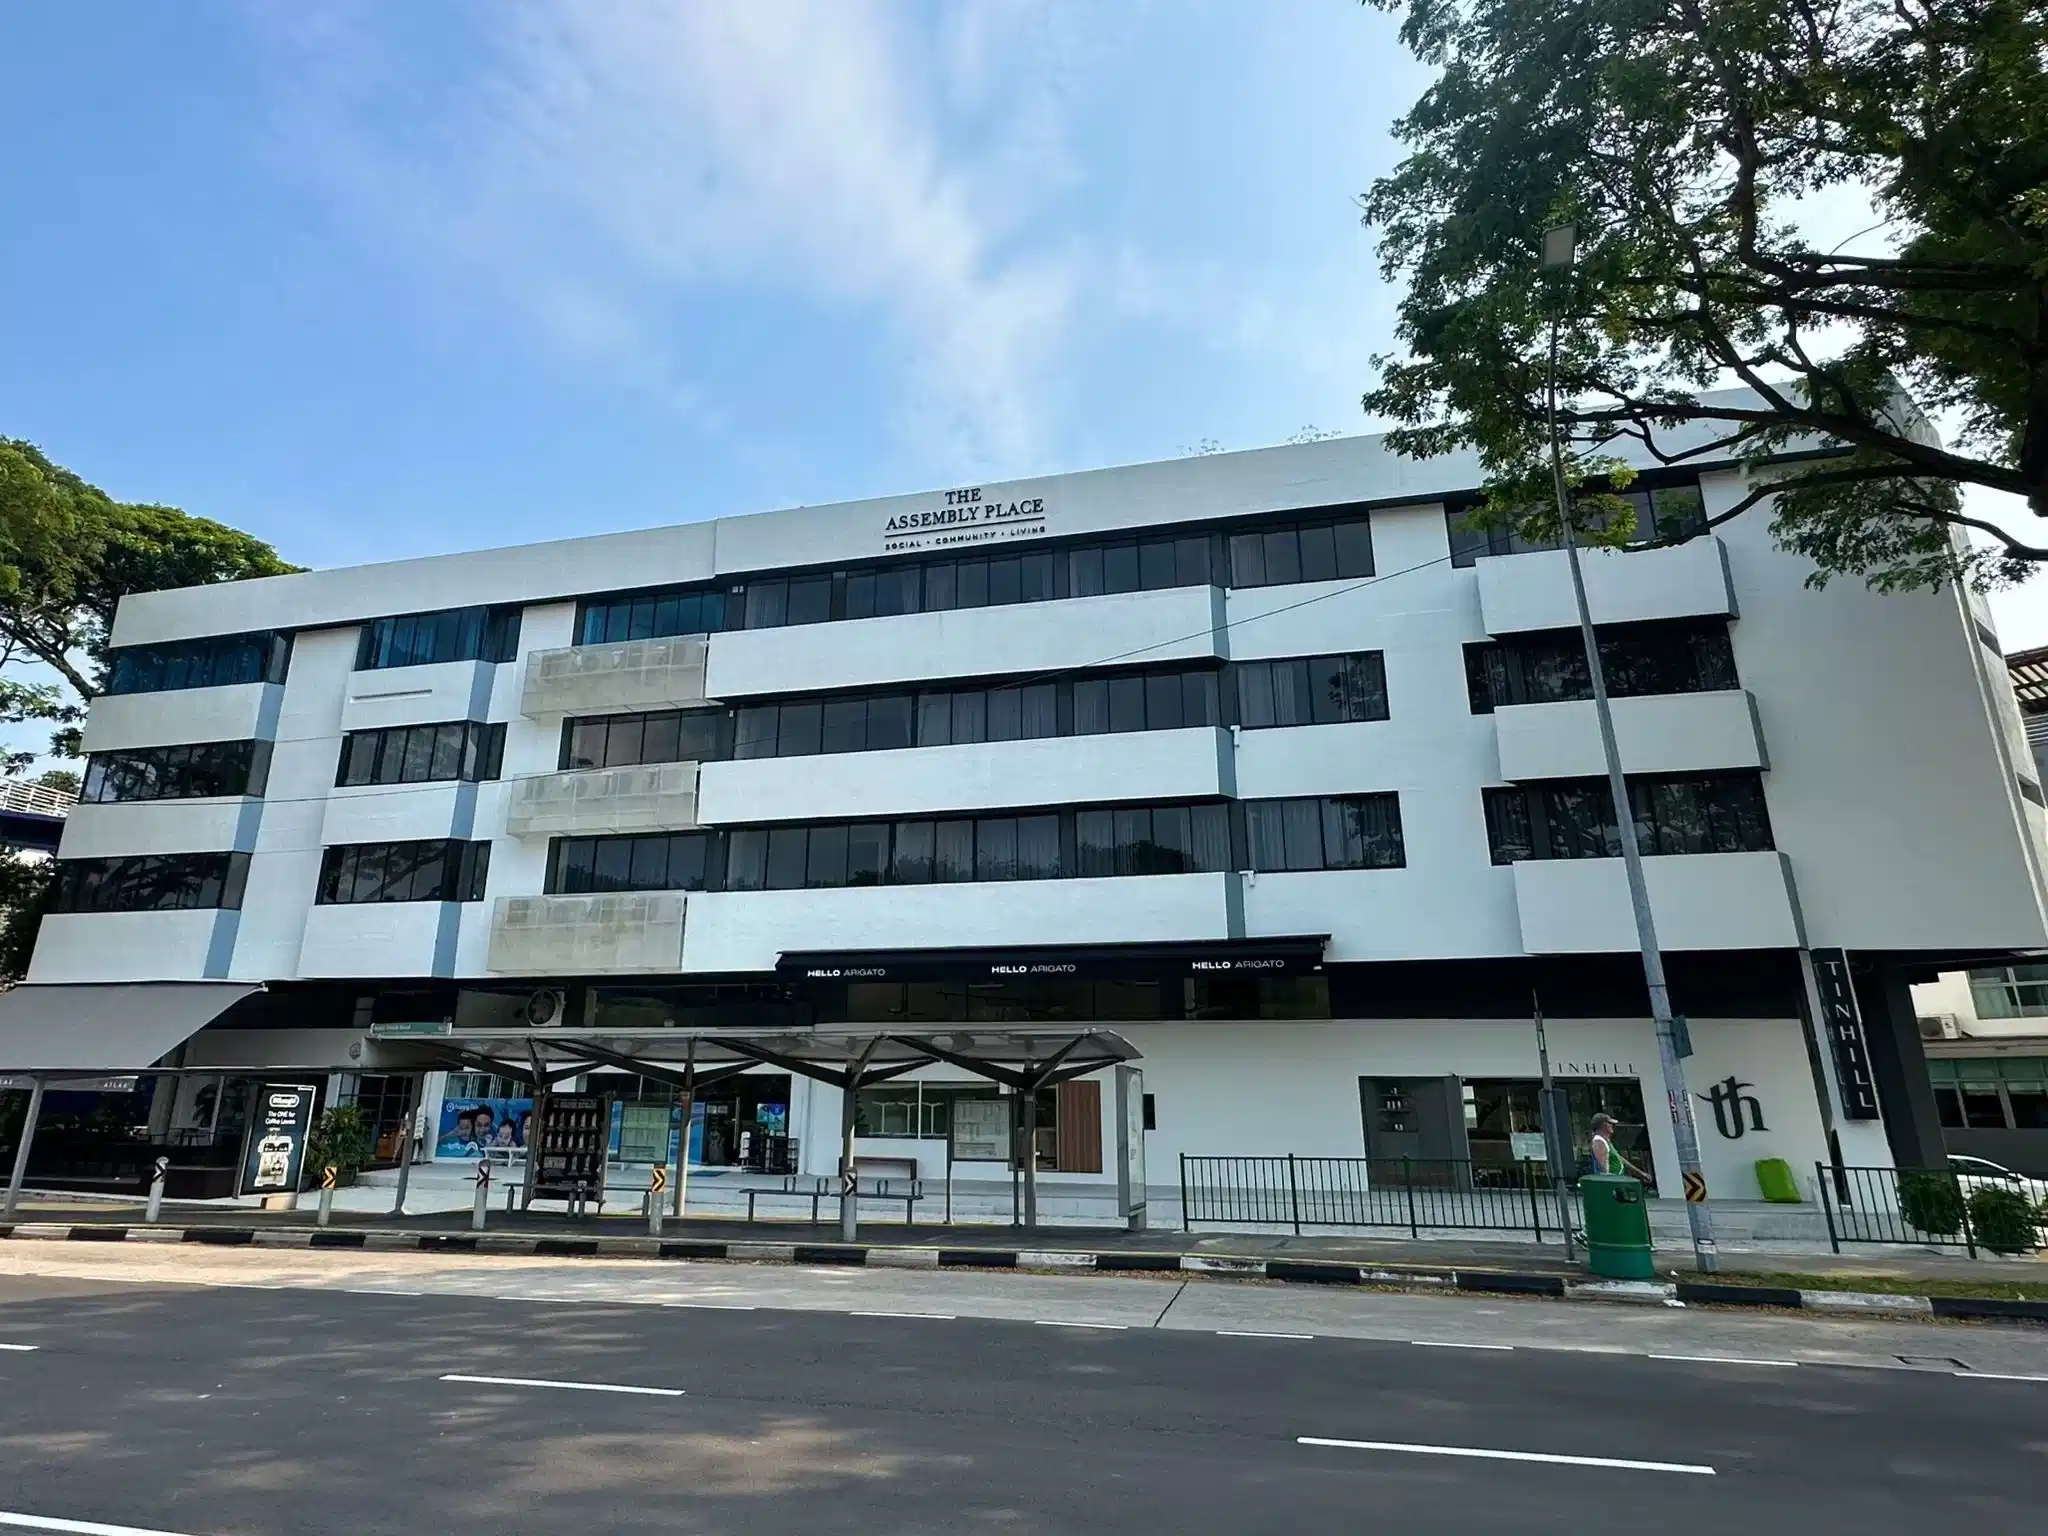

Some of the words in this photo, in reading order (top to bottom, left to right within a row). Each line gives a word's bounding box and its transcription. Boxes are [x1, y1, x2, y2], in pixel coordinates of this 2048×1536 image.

[945, 488, 982, 505] THE
[885, 506, 980, 530] ASSEMBLY
[984, 499, 1044, 519] PLACE
[885, 540, 922, 551] SOCIAL
[935, 531, 997, 545] COMMUNITY
[1010, 526, 1046, 537] LIVING
[991, 965, 1027, 974] HELLO
[1030, 964, 1077, 973] ARIGATO
[1192, 961, 1231, 970] HELLO
[1234, 959, 1285, 969] ARIGATO
[807, 969, 840, 977] HELLO
[843, 968, 886, 977] ARIGATO
[1824, 961, 1875, 1108] TINHILL
[1550, 1063, 1639, 1074] INHILL
